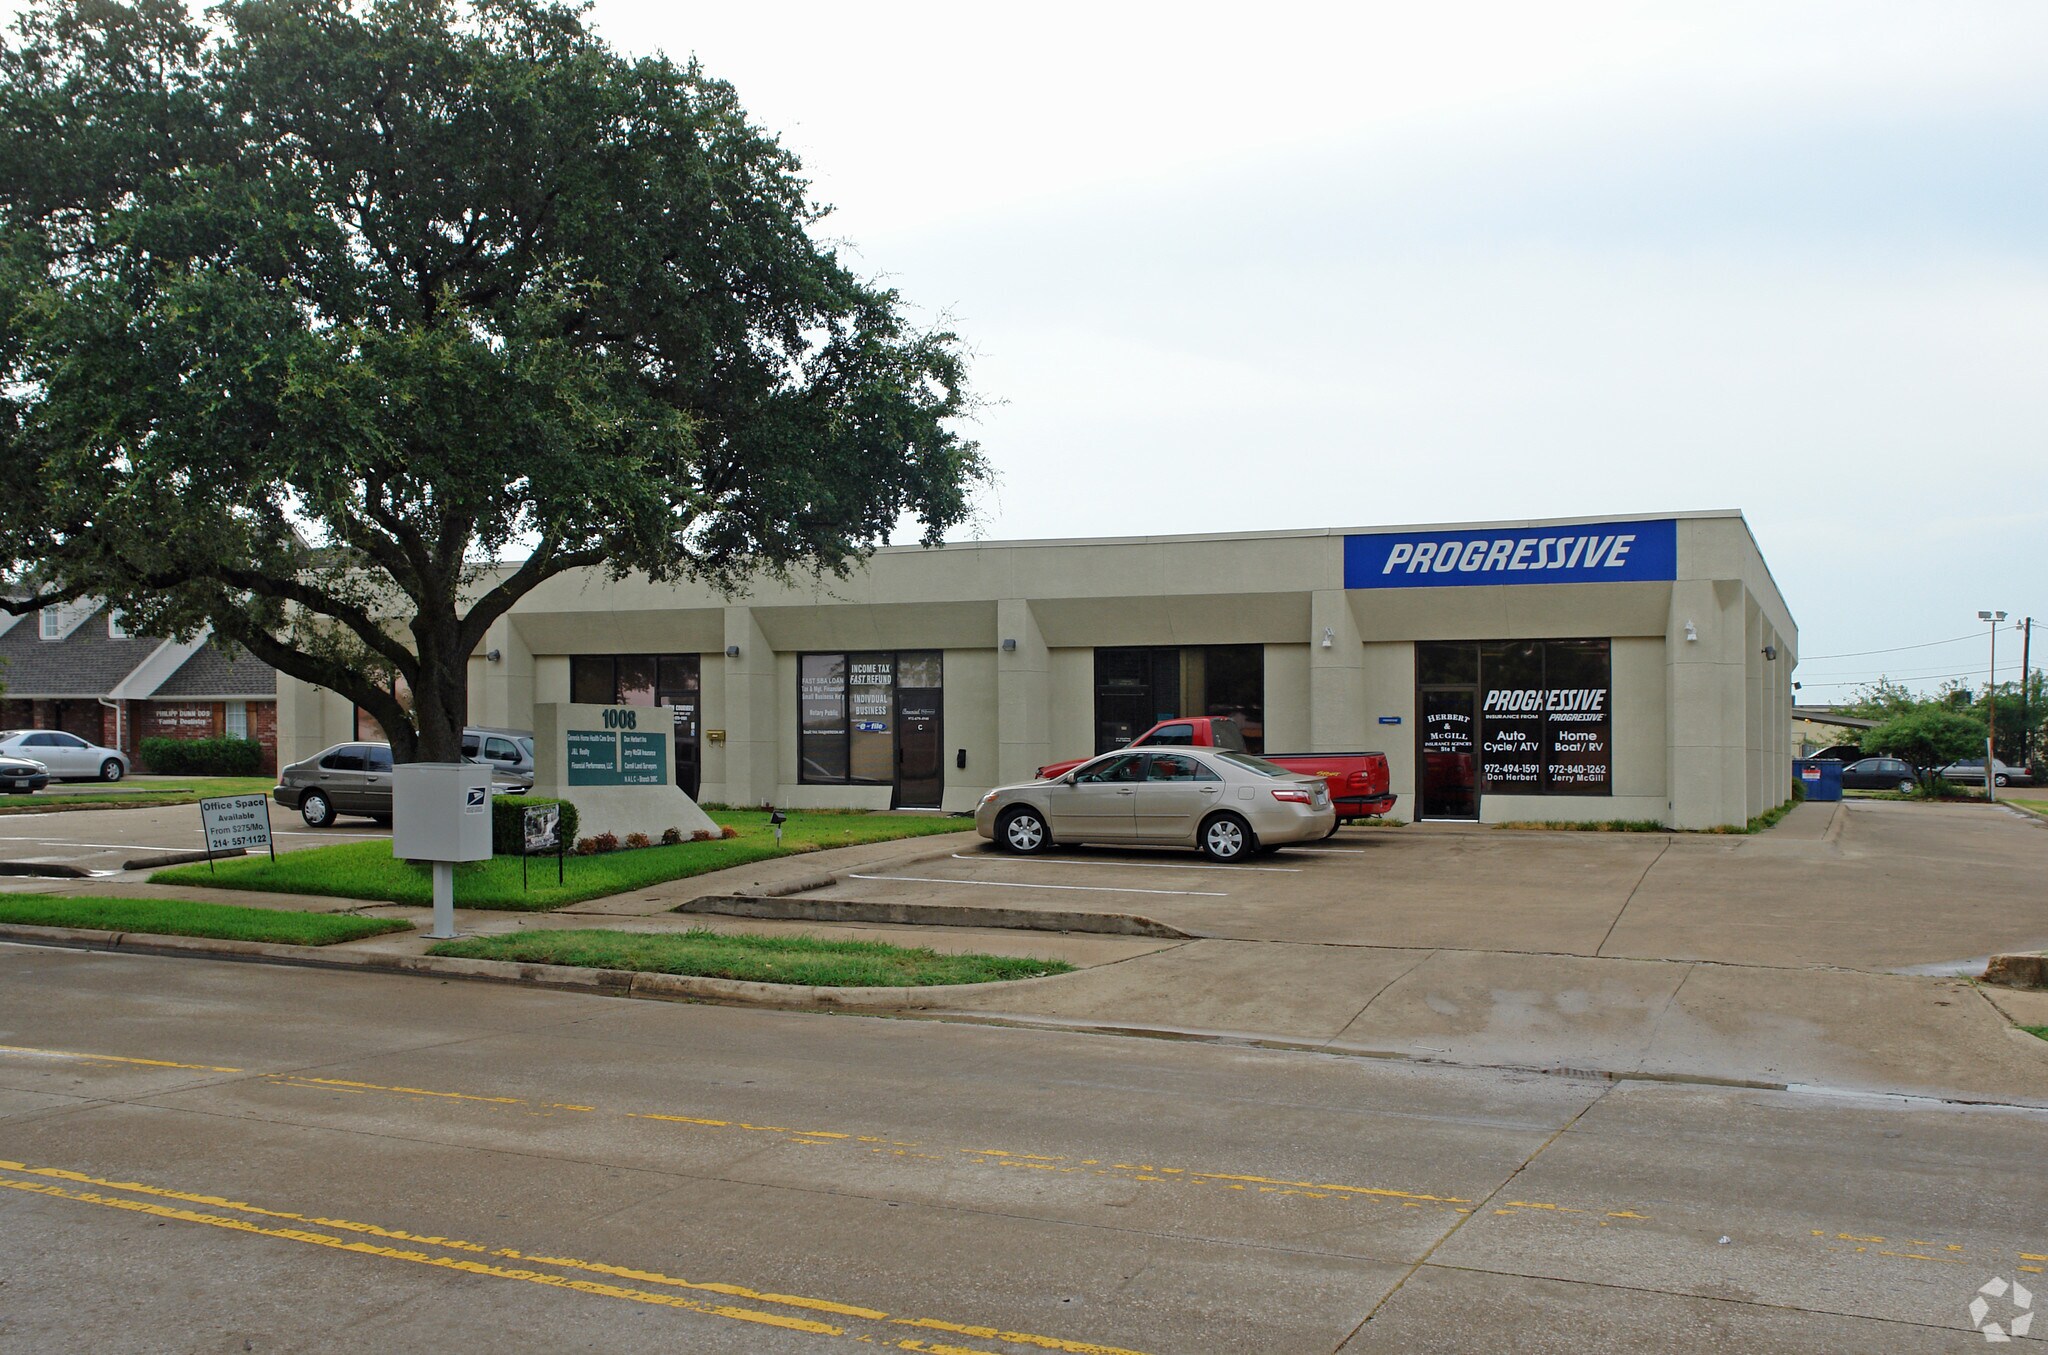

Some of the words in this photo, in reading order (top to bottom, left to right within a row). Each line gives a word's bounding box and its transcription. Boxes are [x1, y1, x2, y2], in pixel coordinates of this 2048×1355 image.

[1382, 534, 1636, 575] PROGRESSIVE
[851, 664, 876, 673] INCOME
[877, 664, 891, 673] TAX
[802, 677, 815, 685] FAST
[850, 675, 866, 685] FAST
[866, 675, 892, 685] REFUND
[1483, 689, 1607, 711] PROGRESSIVE
[809, 709, 824, 717] Notary
[855, 706, 887, 715] BUSINESS
[159, 718, 178, 726] Family
[602, 708, 637, 730] 1008
[1427, 713, 1470, 723] HERBERT
[1548, 713, 1603, 721] PROGRESSIVE
[1443, 722, 1451, 730] &
[1430, 732, 1468, 740] McGILL
[1496, 730, 1527, 741] Auto
[1559, 731, 1598, 741] Home
[1483, 742, 1518, 753] Cycle/
[1519, 742, 1539, 751] ATV
[1554, 742, 1587, 753] Boat/
[1588, 742, 1604, 752] RV
[1484, 764, 1540, 774] 972-494-1591
[1548, 764, 1607, 774] 972-840-1262
[1506, 773, 1538, 781] Herbert
[1552, 774, 1575, 783] Jerry
[1576, 774, 1604, 782] McGill
[203, 801, 233, 811] Office
[235, 799, 264, 809] Space
[218, 812, 255, 822] Available
[210, 827, 231, 835] From
[232, 823, 265, 834] $275/Mo.
[231, 834, 267, 846] 557-1122
